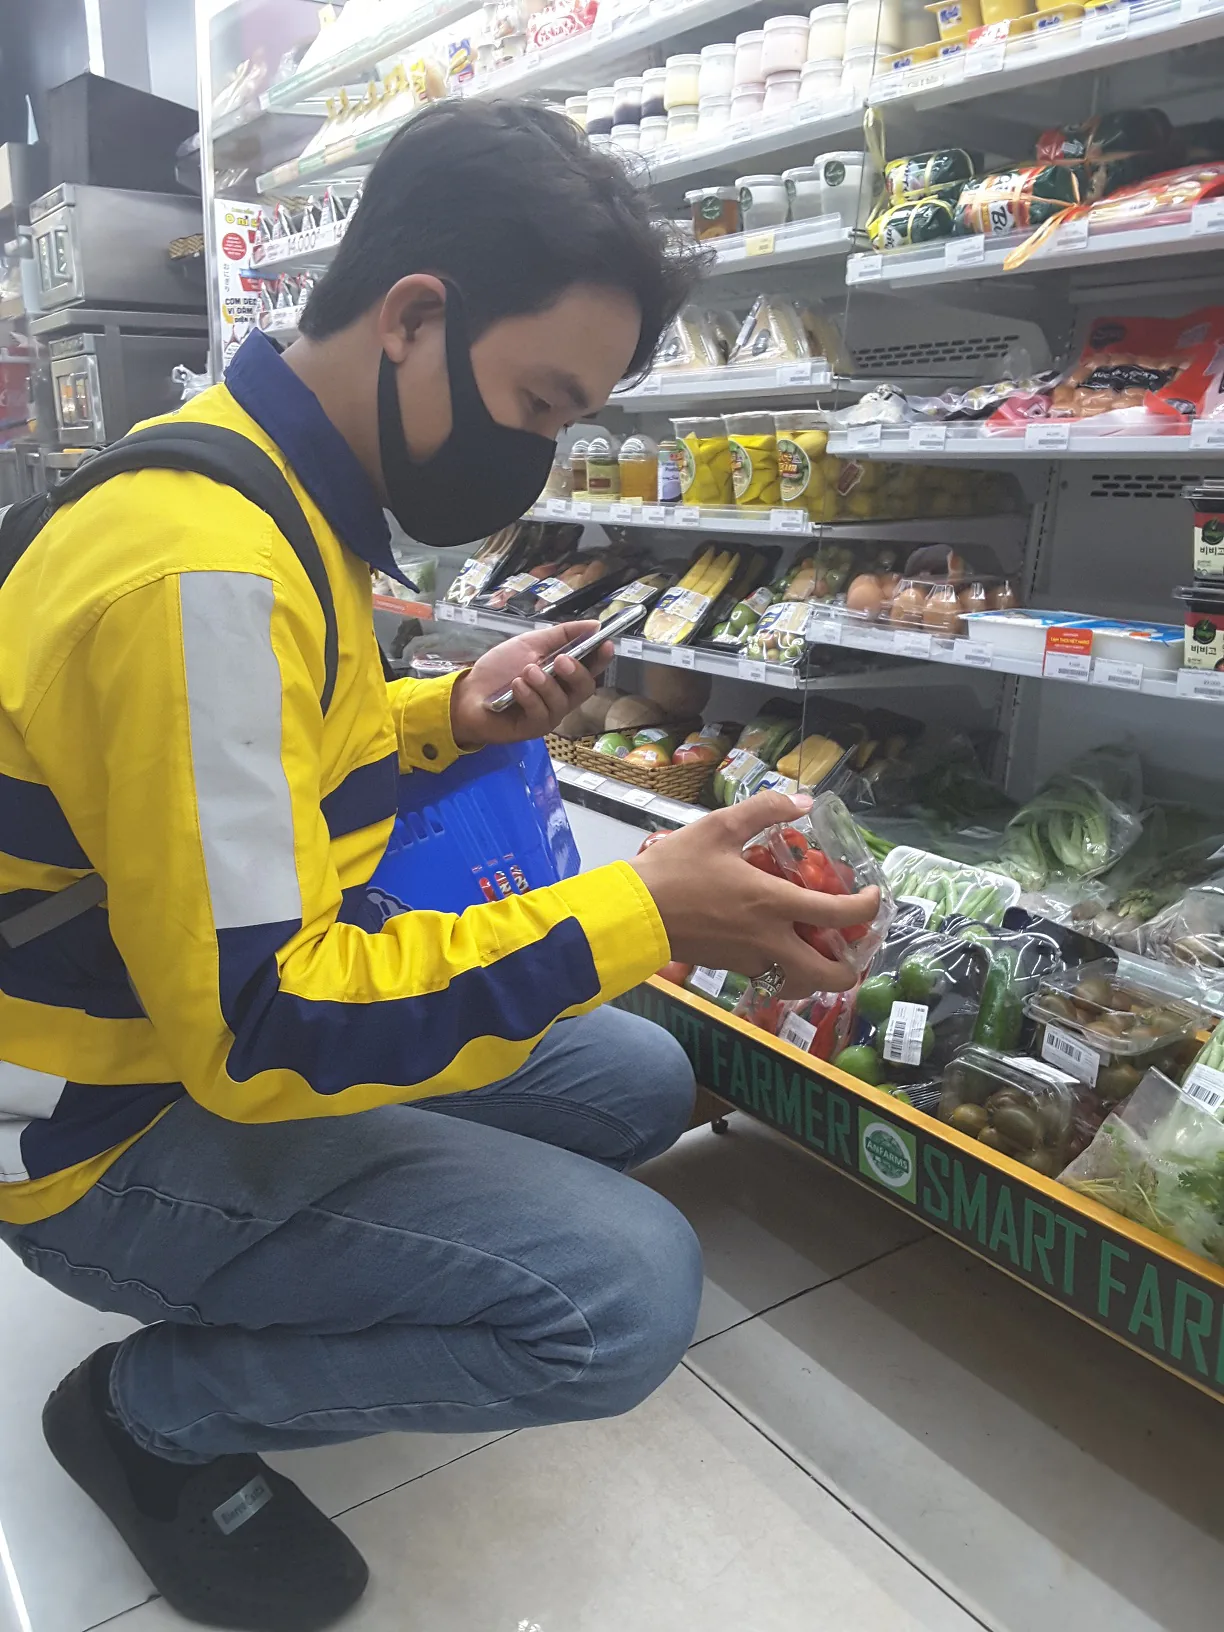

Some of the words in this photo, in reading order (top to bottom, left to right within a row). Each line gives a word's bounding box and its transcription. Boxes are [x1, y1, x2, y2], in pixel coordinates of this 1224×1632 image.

[711, 1029, 853, 1166] FARMER
[923, 1144, 1087, 1296] SMART
[1099, 1239, 1224, 1385] FAR
